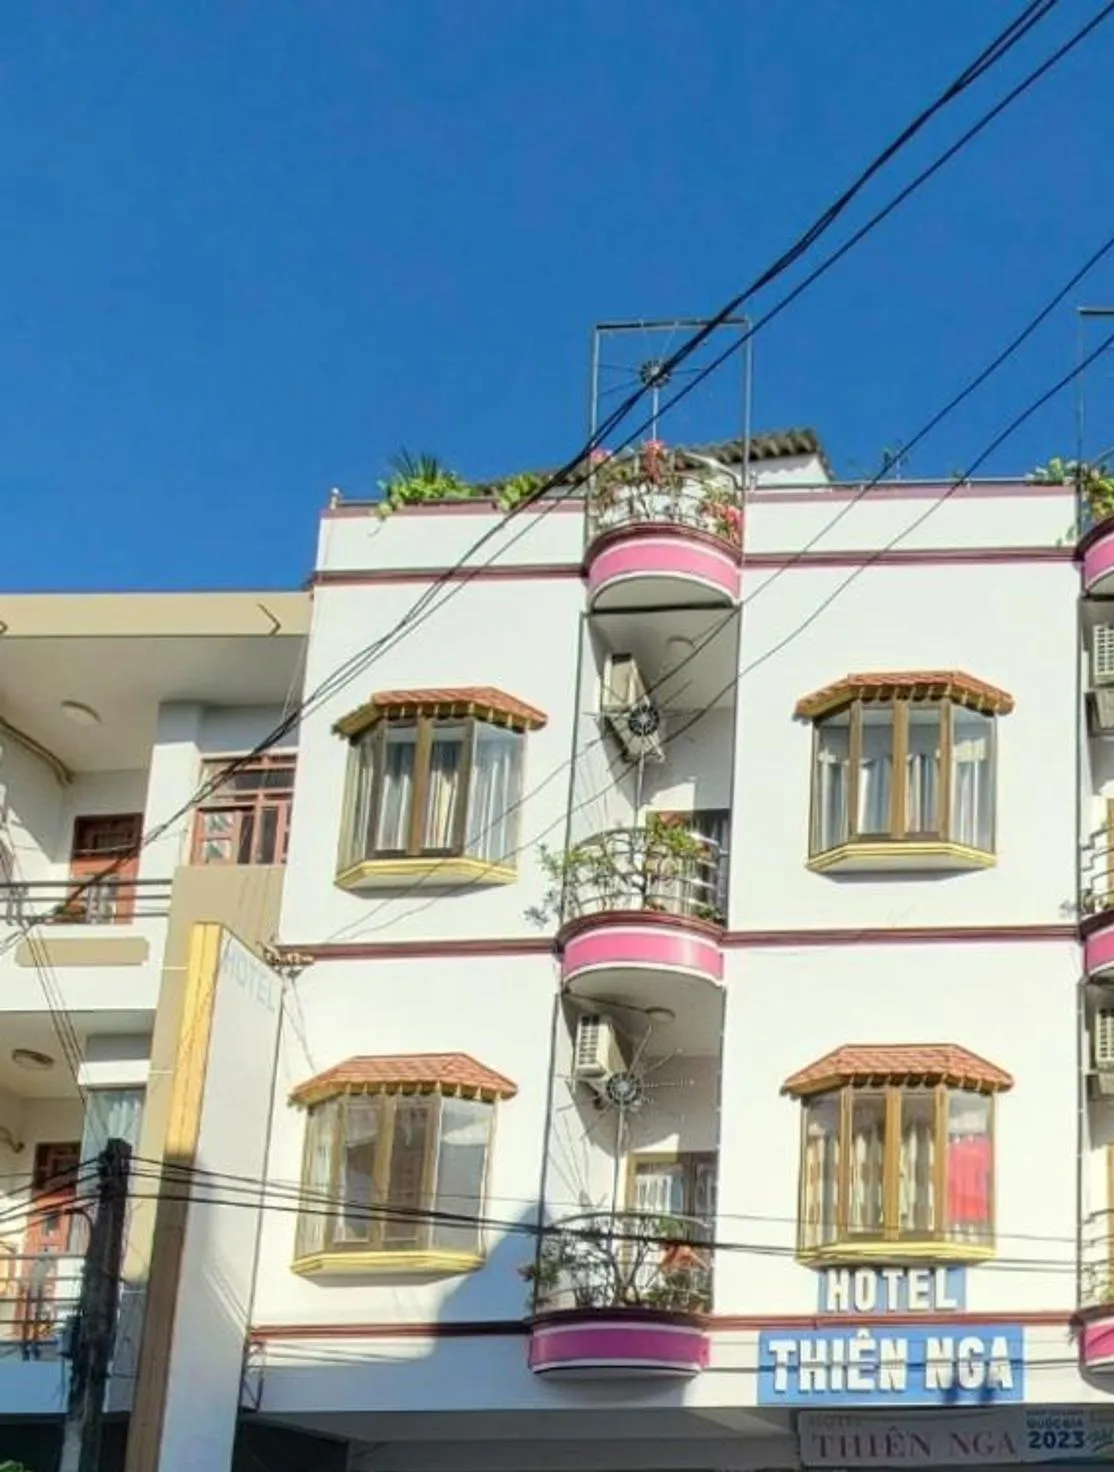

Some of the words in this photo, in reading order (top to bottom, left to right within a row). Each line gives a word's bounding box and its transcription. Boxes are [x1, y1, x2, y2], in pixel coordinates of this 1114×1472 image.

[825, 1266, 957, 1312] HOTEL
[768, 1327, 908, 1393] THIÊN
[924, 1335, 1015, 1391] NGA
[813, 1425, 933, 1458] THIÊN
[950, 1430, 1017, 1457] NGA
[1028, 1430, 1085, 1449] 2023
